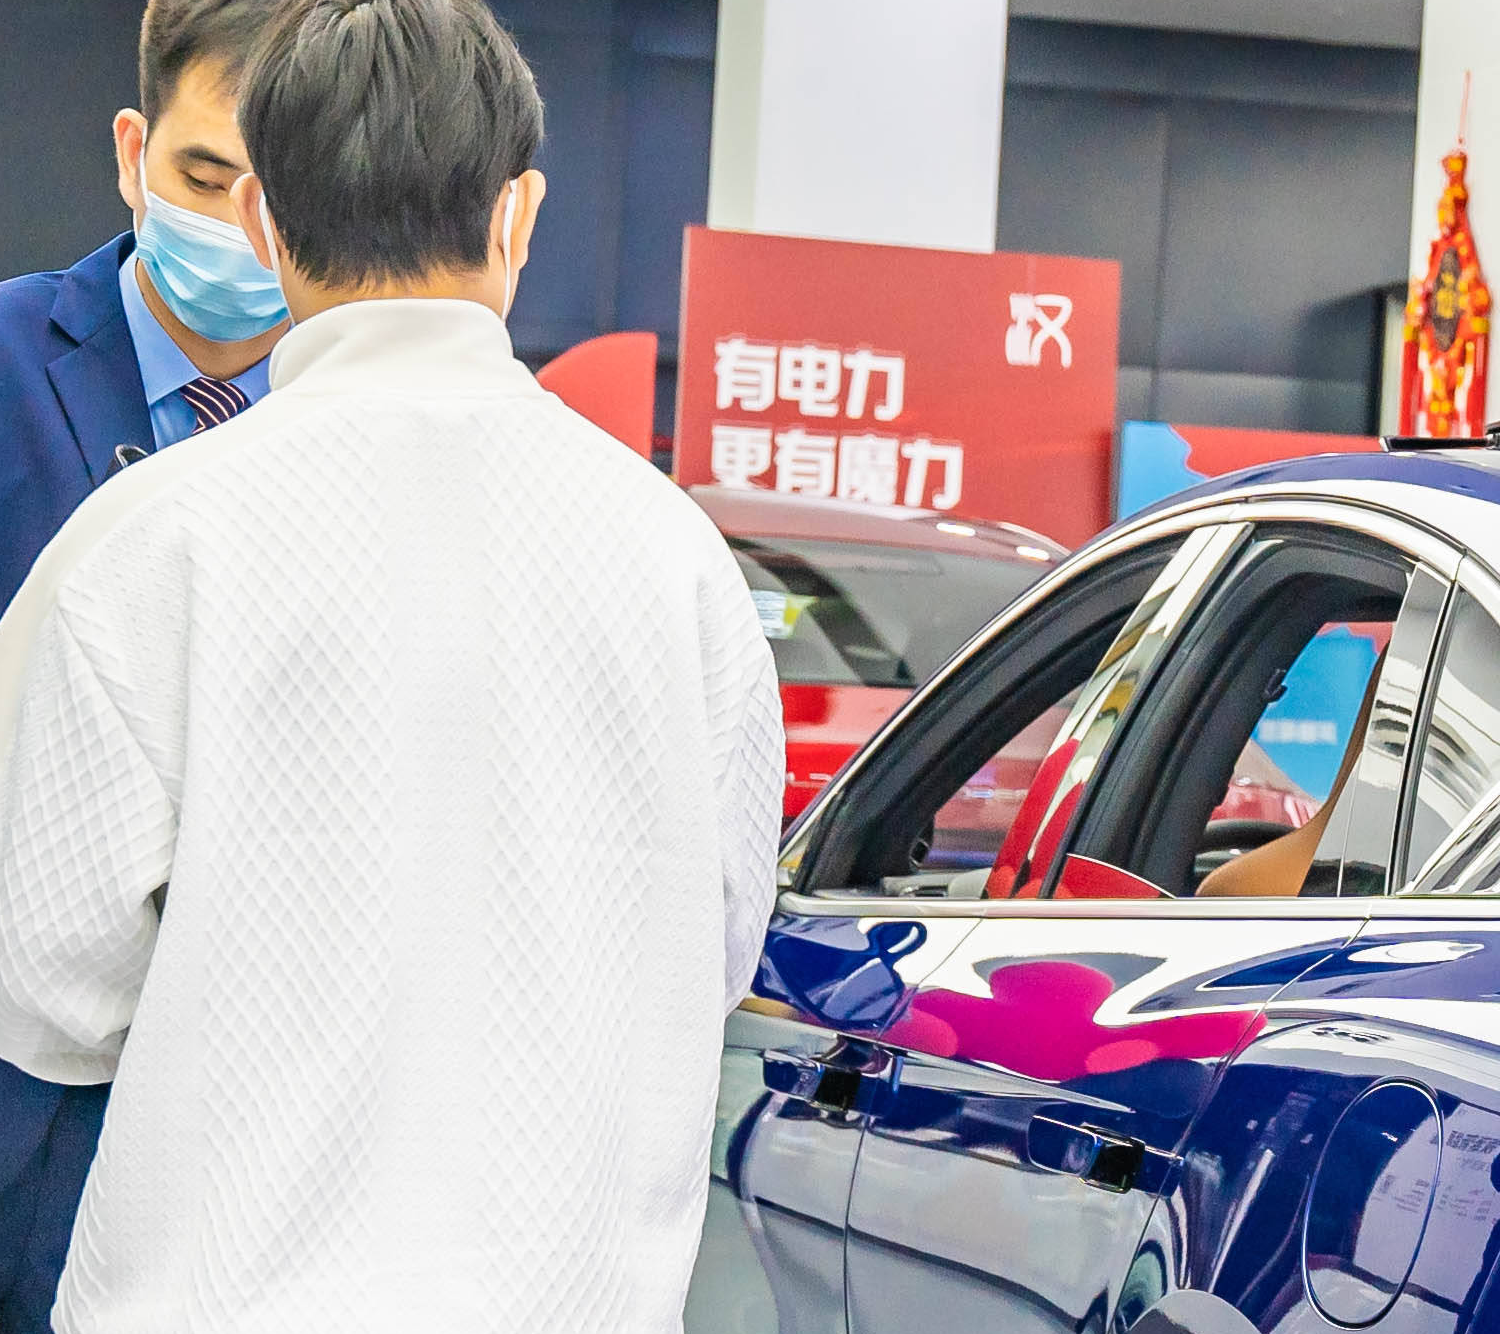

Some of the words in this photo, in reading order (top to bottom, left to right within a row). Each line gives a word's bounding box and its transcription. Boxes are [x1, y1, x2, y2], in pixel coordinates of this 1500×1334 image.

[714, 336, 906, 421] 有电力
[711, 423, 965, 510] 更有魔力
